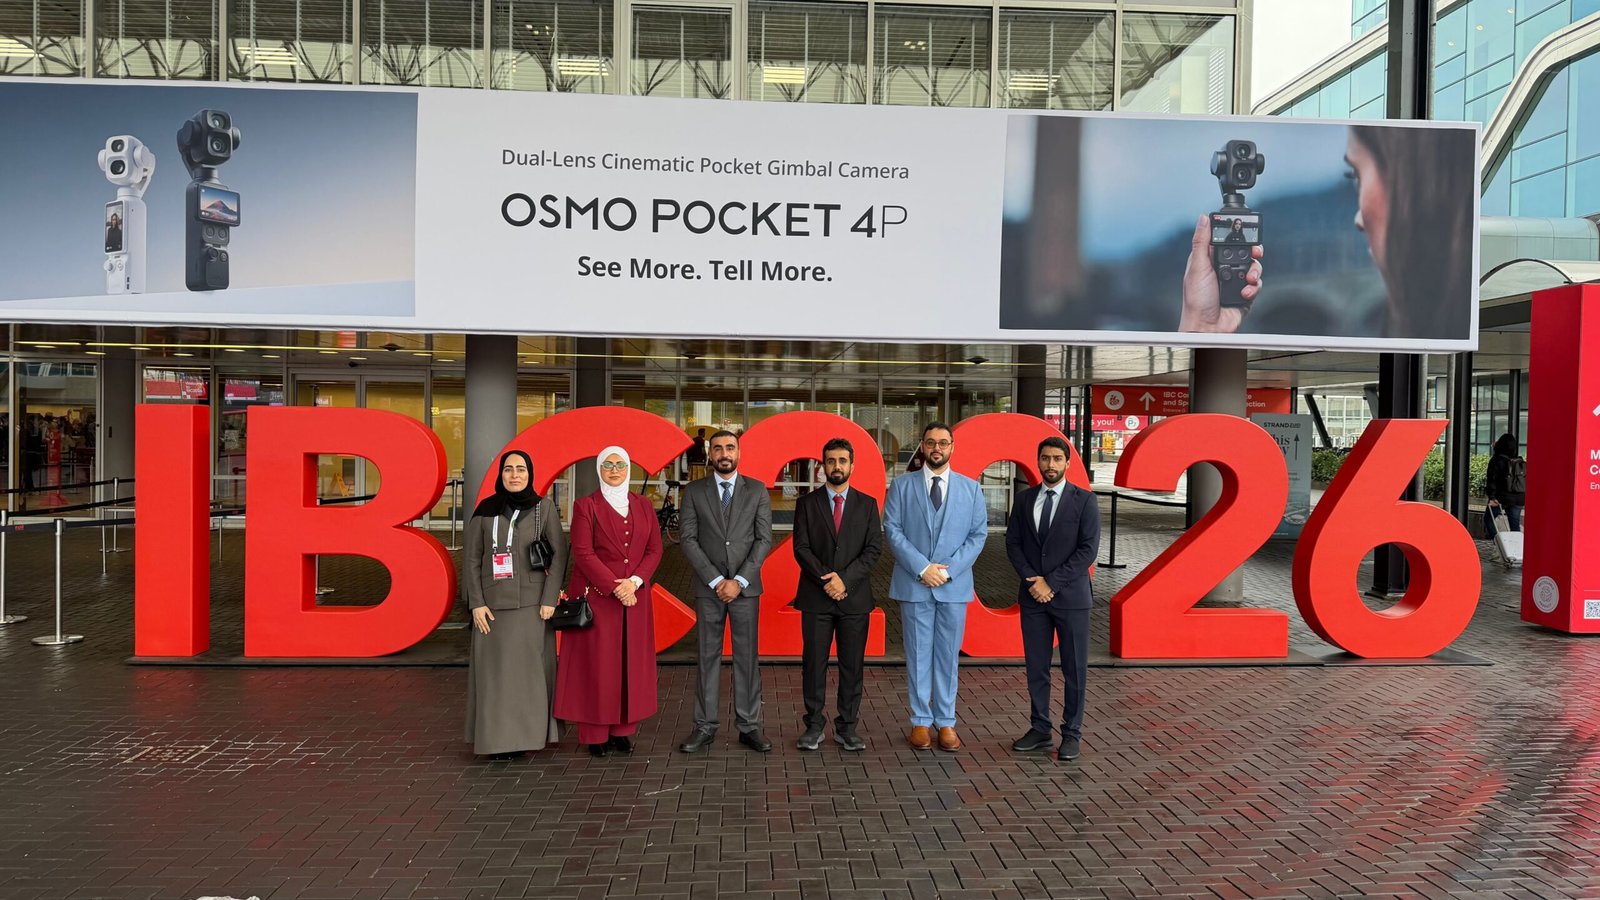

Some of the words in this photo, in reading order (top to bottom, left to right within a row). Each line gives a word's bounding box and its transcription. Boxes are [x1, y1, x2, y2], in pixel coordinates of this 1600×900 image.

[502, 149, 596, 169] Dual-Lens
[601, 153, 695, 173] Cinematic
[700, 157, 763, 176] Pocket
[767, 159, 833, 177] Gimbal
[838, 162, 909, 179] Camera
[501, 193, 637, 231] OSMO
[652, 199, 841, 237] POCKET
[850, 205, 908, 239] 4P
[577, 255, 622, 277] See
[630, 257, 702, 280] More.
[708, 259, 753, 281] Tell
[761, 261, 833, 282] More.
